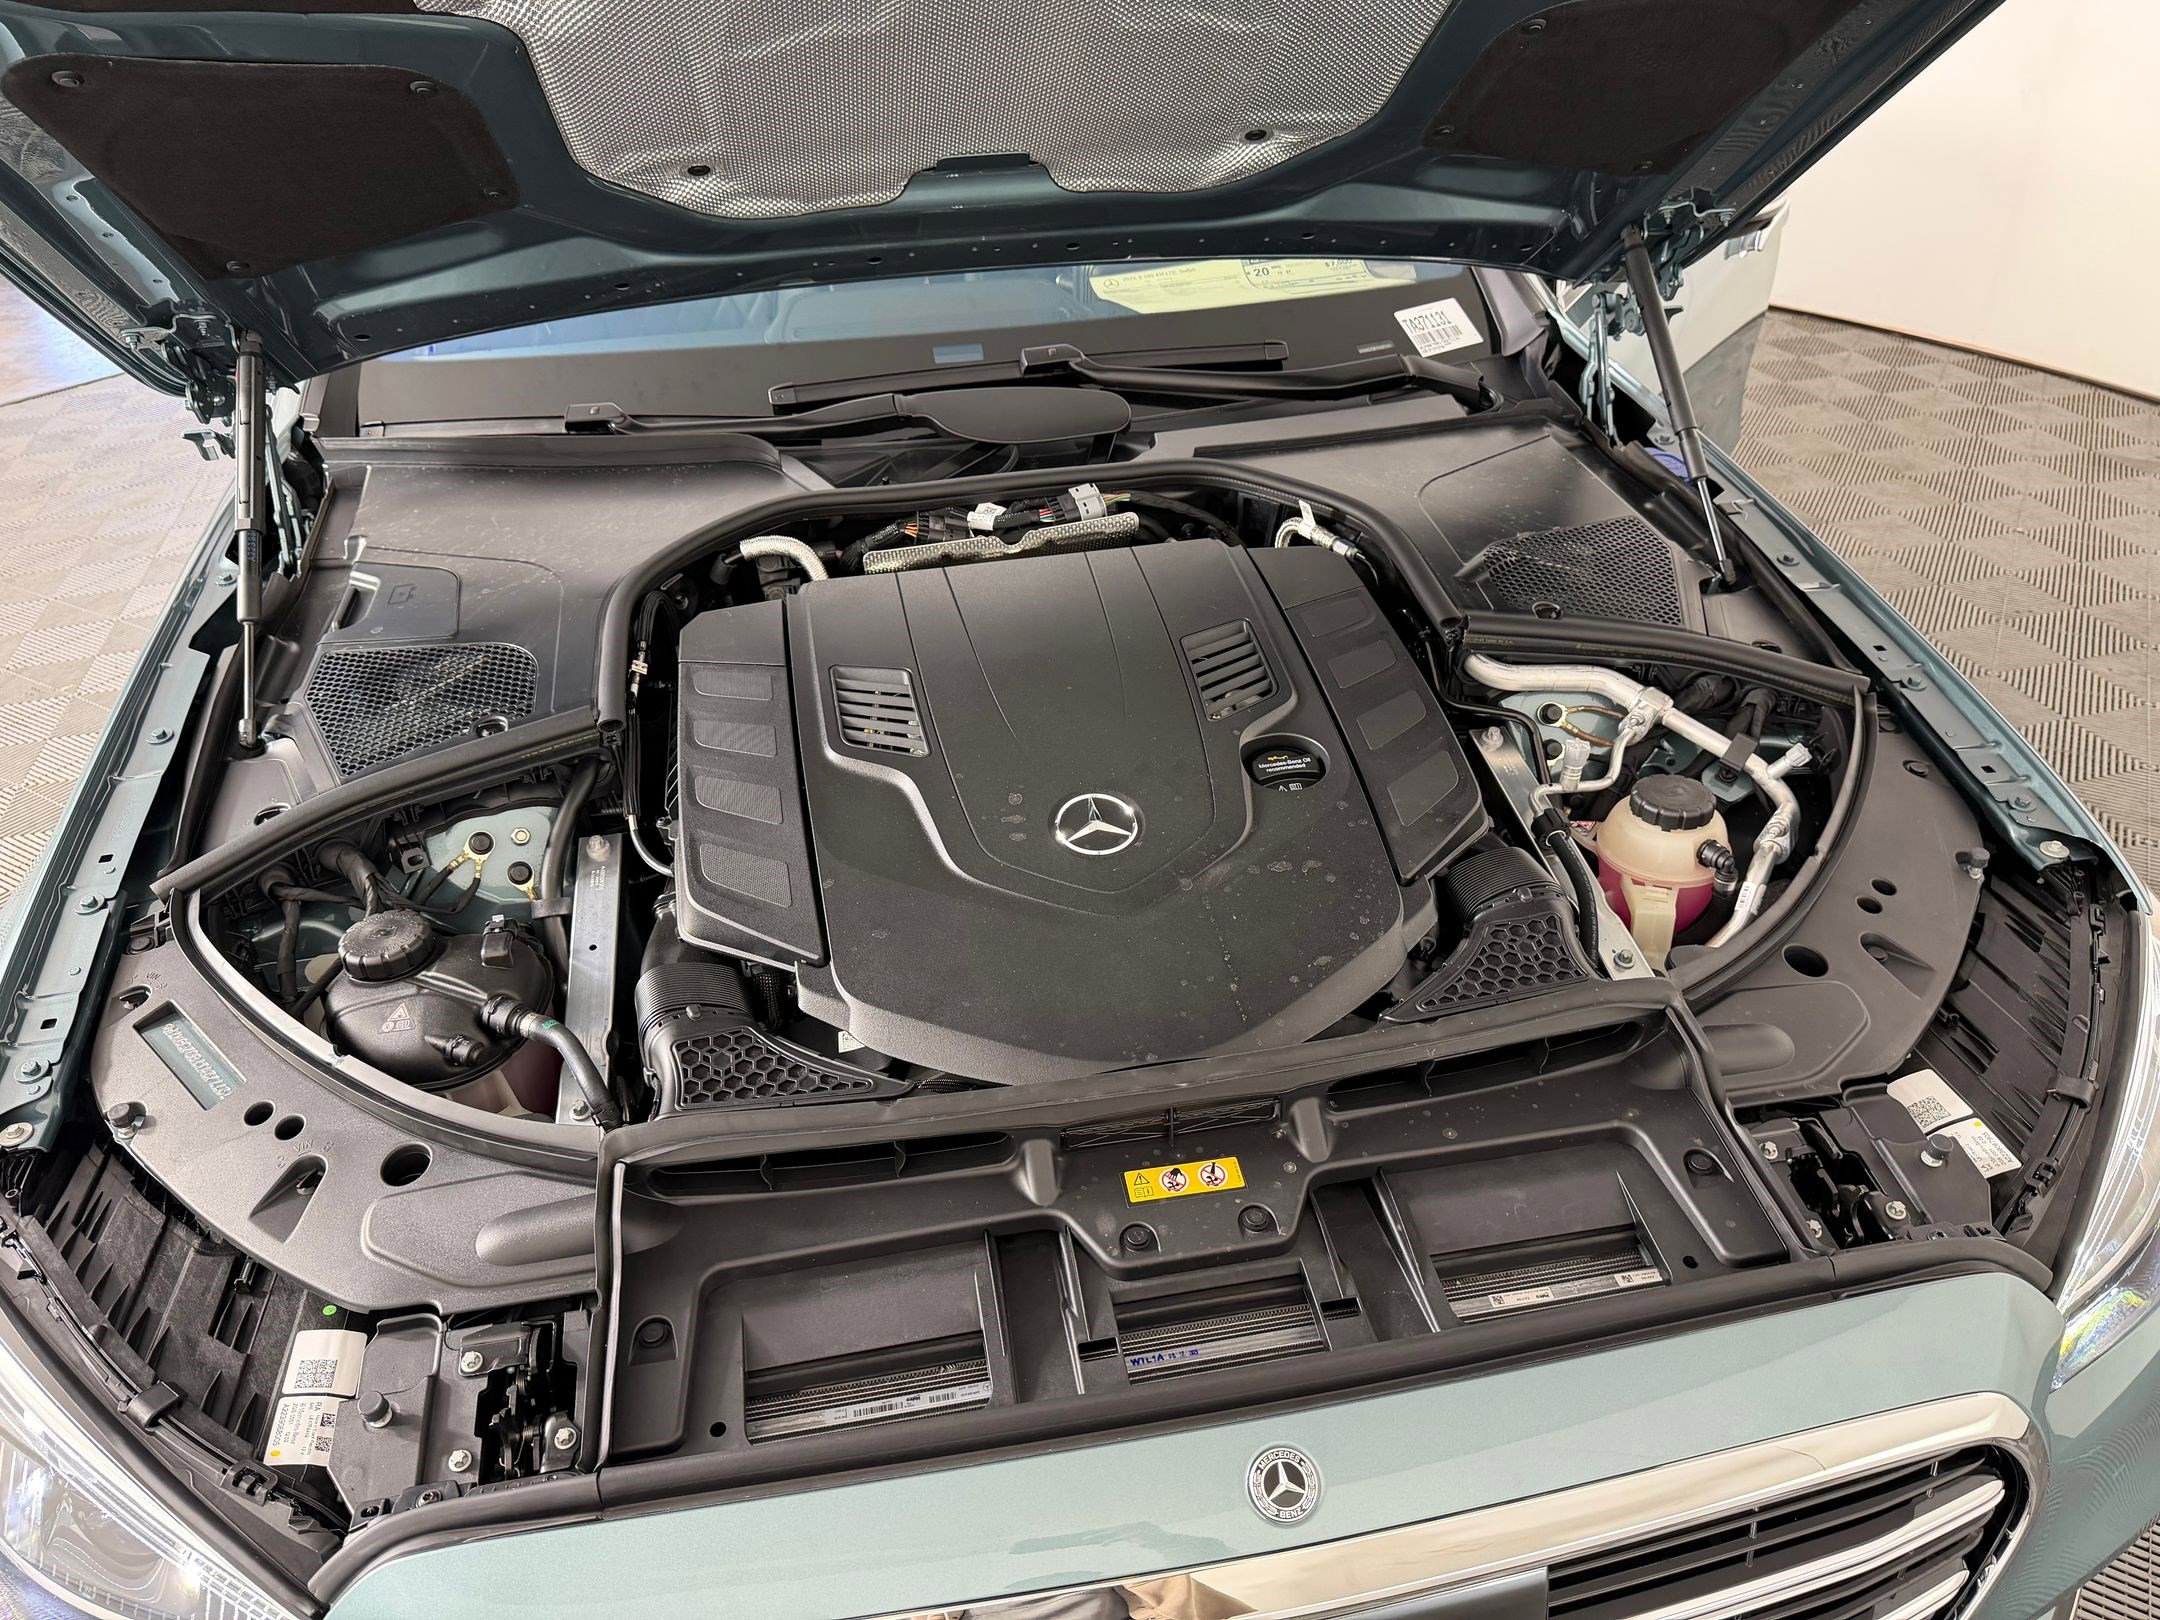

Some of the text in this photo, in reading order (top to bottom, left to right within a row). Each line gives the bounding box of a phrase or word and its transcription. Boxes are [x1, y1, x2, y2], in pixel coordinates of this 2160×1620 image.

[1253, 267, 1270, 277] 20
[1402, 309, 1452, 335] TA371131
[1259, 757, 1302, 769] Mercedes-Benz
[1266, 762, 1306, 773] recommended
[293, 1139, 314, 1152] VIN
[1258, 1450, 1301, 1470] MERCEDES
[1279, 1508, 1304, 1519] BENZ
